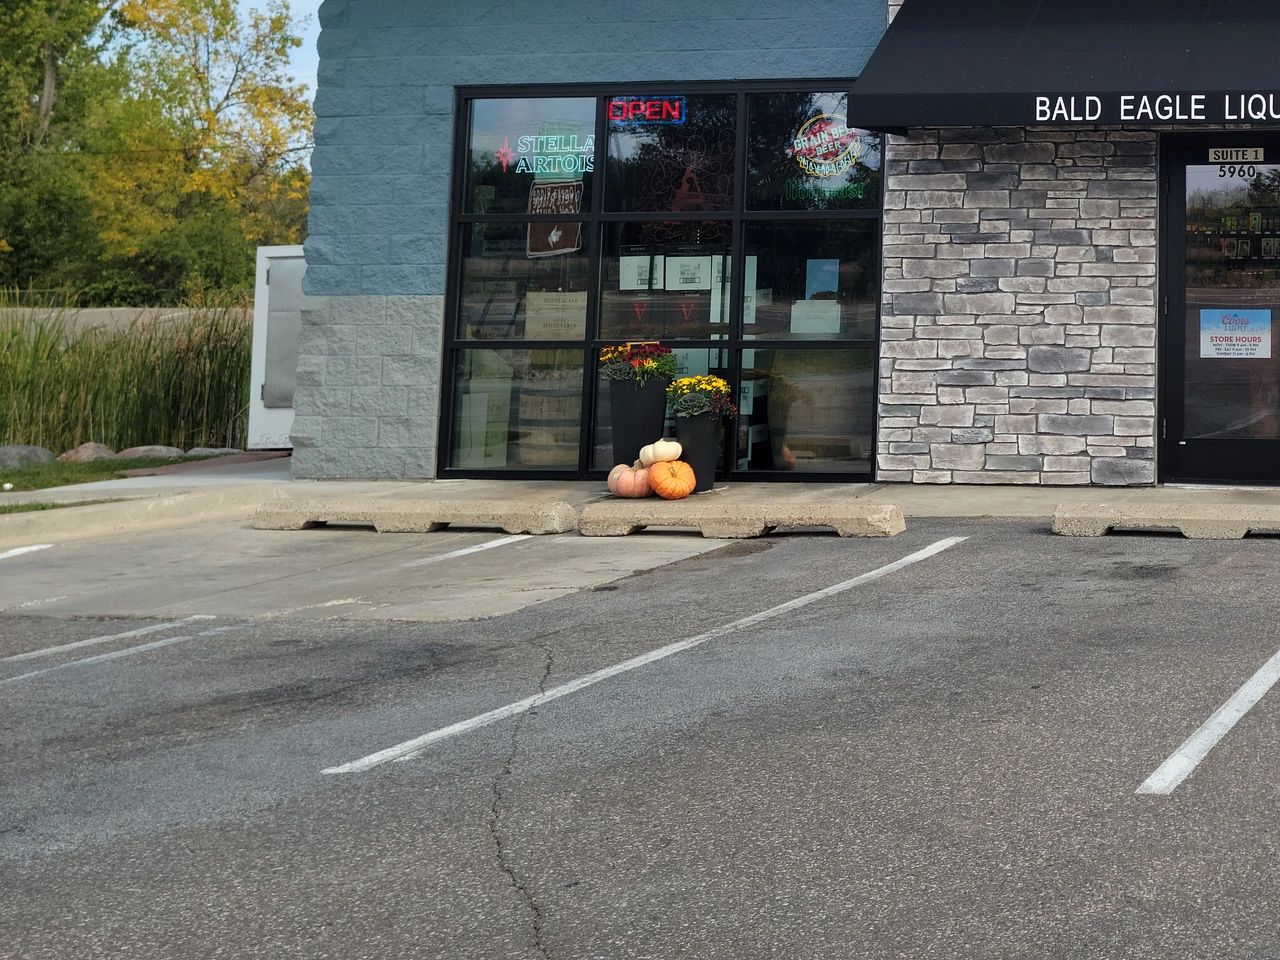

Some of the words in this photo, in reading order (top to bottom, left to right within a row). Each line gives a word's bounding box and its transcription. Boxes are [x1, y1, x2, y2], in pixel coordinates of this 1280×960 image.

[608, 101, 680, 120] OPEN
[1035, 96, 1101, 121] BALD
[1120, 94, 1206, 120] EAGLE
[517, 134, 595, 153] STELLA
[793, 130, 829, 151] GRAIN
[816, 141, 841, 155] BEER
[515, 155, 594, 174] ARTOIS
[1213, 149, 1248, 161] SUITE
[1252, 149, 1260, 160] 1
[1218, 165, 1256, 178] 5960
